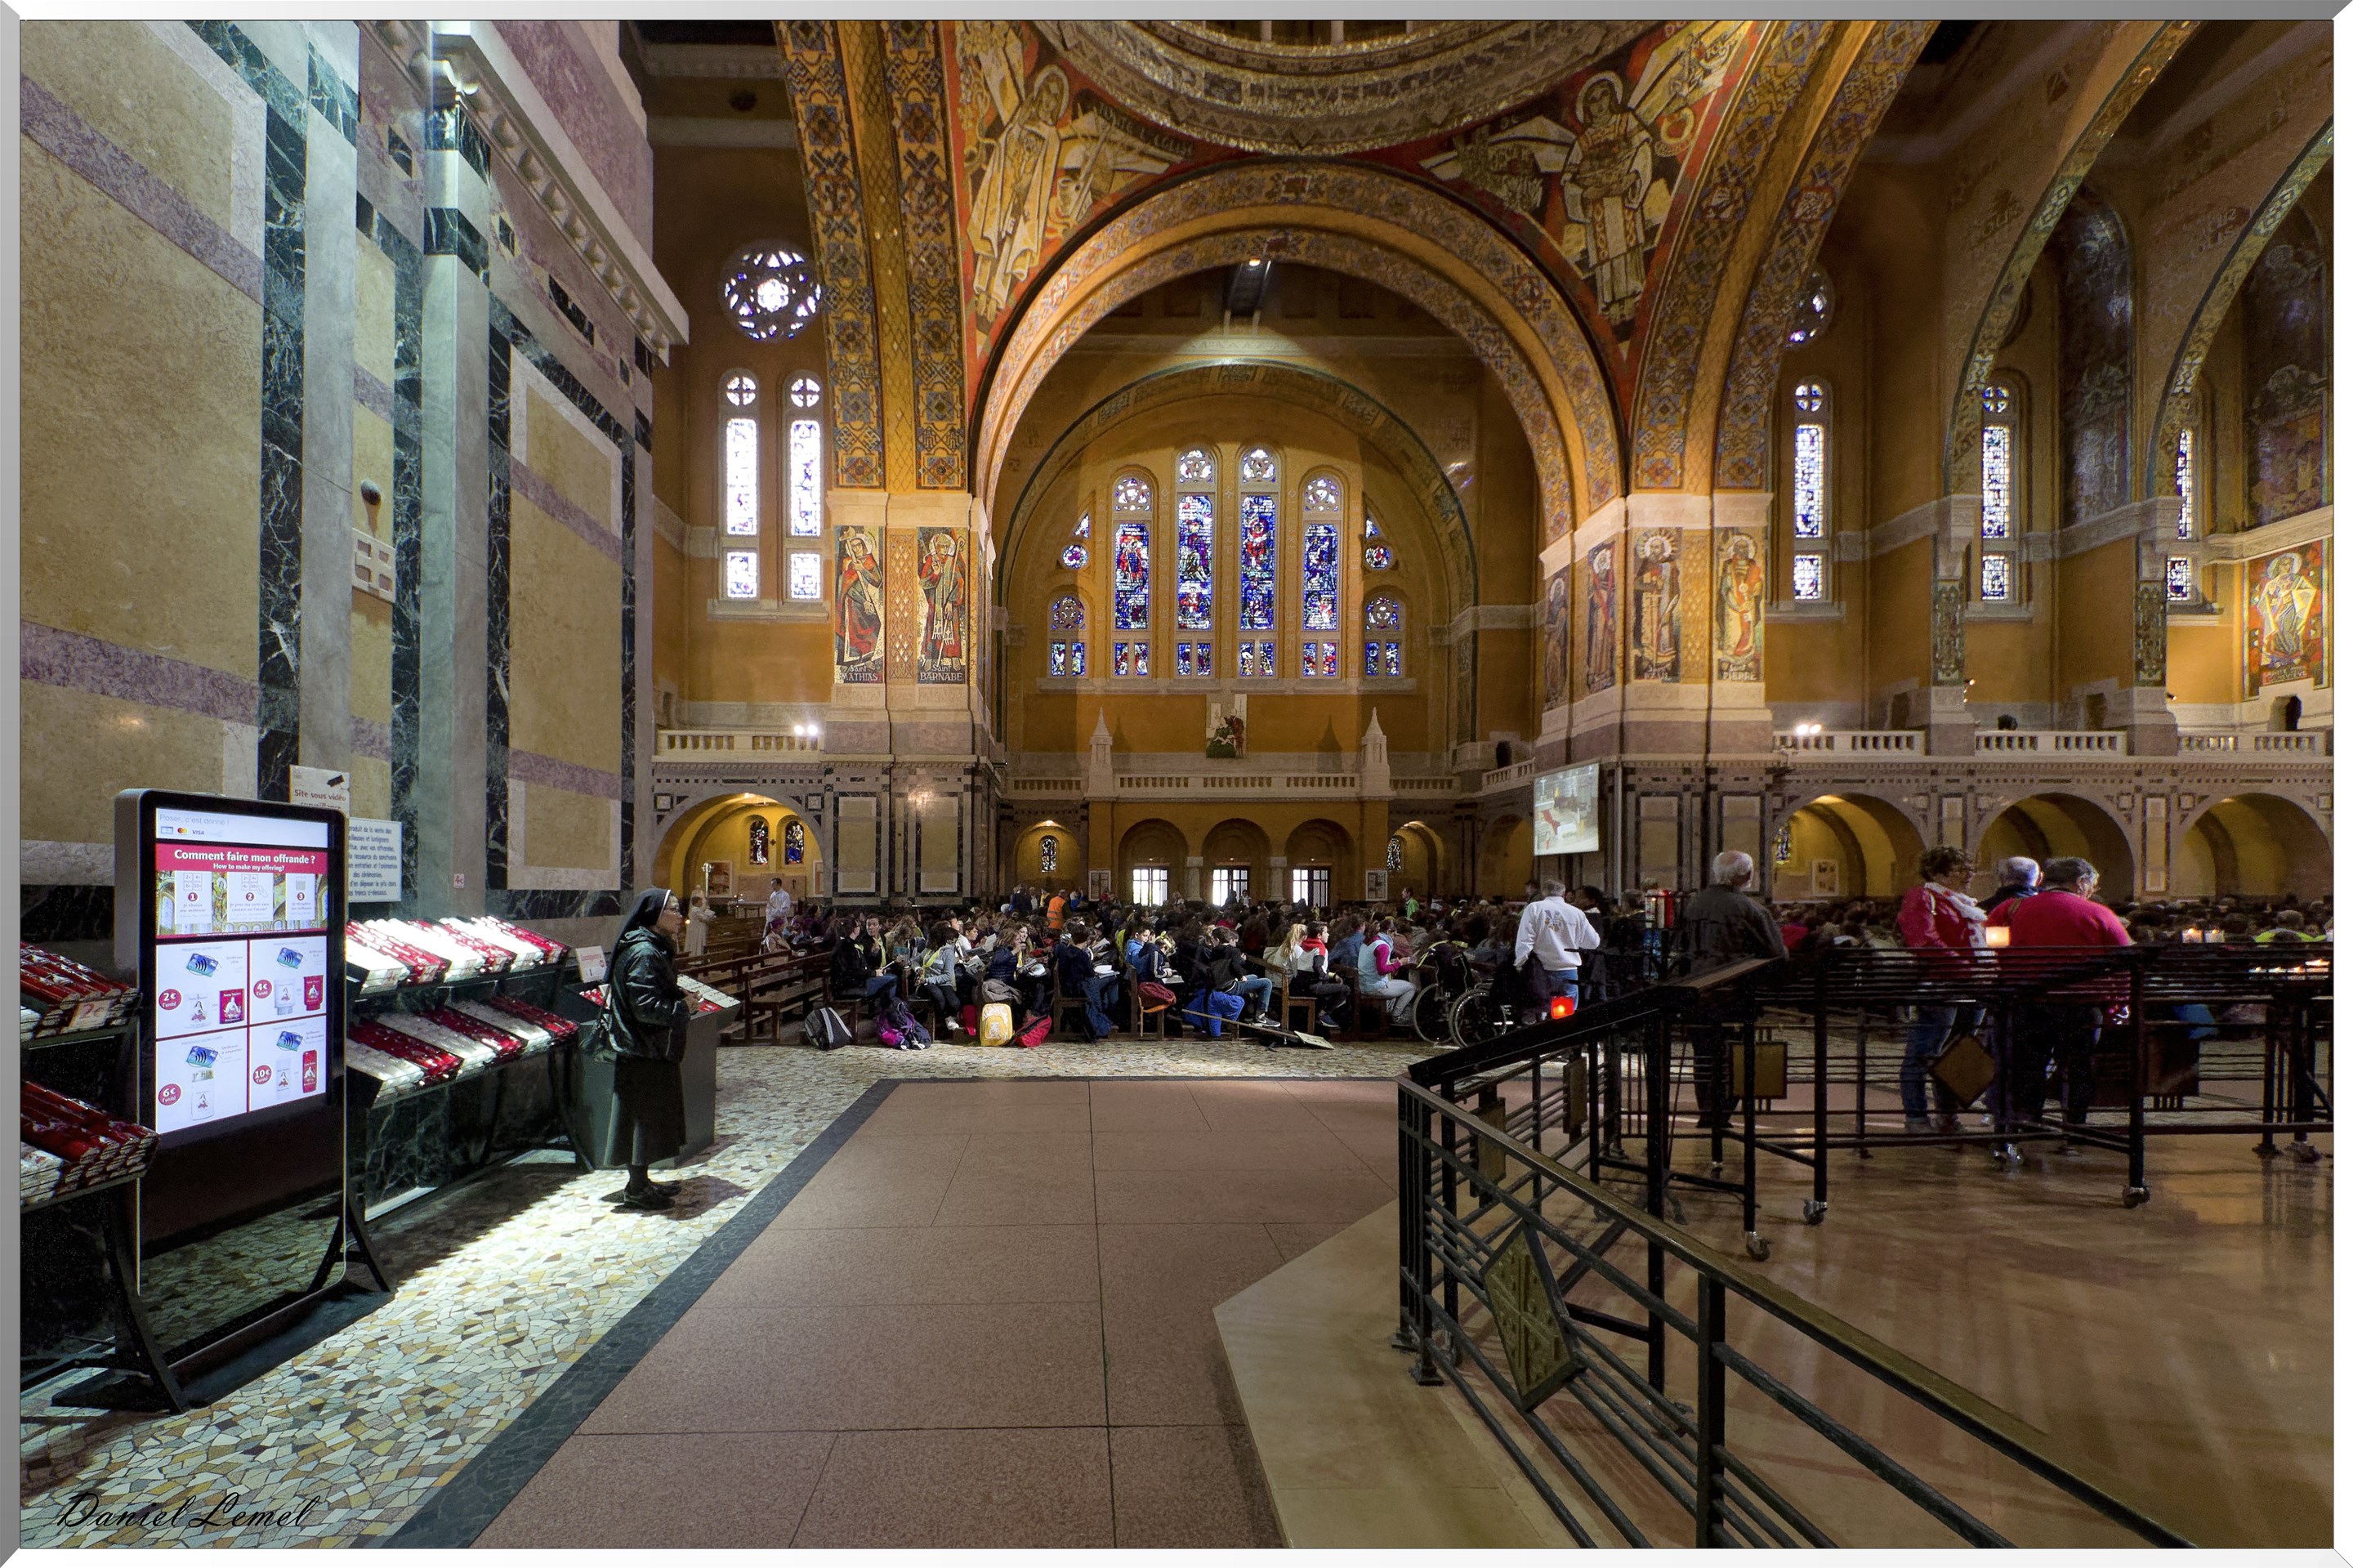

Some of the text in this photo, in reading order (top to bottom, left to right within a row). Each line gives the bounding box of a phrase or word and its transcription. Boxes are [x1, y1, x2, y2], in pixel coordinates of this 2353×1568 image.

[850, 664, 867, 672] Saint
[932, 664, 951, 672] Saint
[839, 672, 878, 681] MATHIAS
[294, 789, 309, 797] Site
[328, 793, 346, 802] vidéo
[174, 850, 316, 864] Comment faire mon offrande ?
[261, 864, 285, 873] offering?
[257, 983, 268, 991] 4€
[163, 992, 176, 1002] 2€
[80, 1003, 105, 1020] 2€
[254, 1069, 270, 1079] 10€
[163, 1088, 176, 1097] 6€
